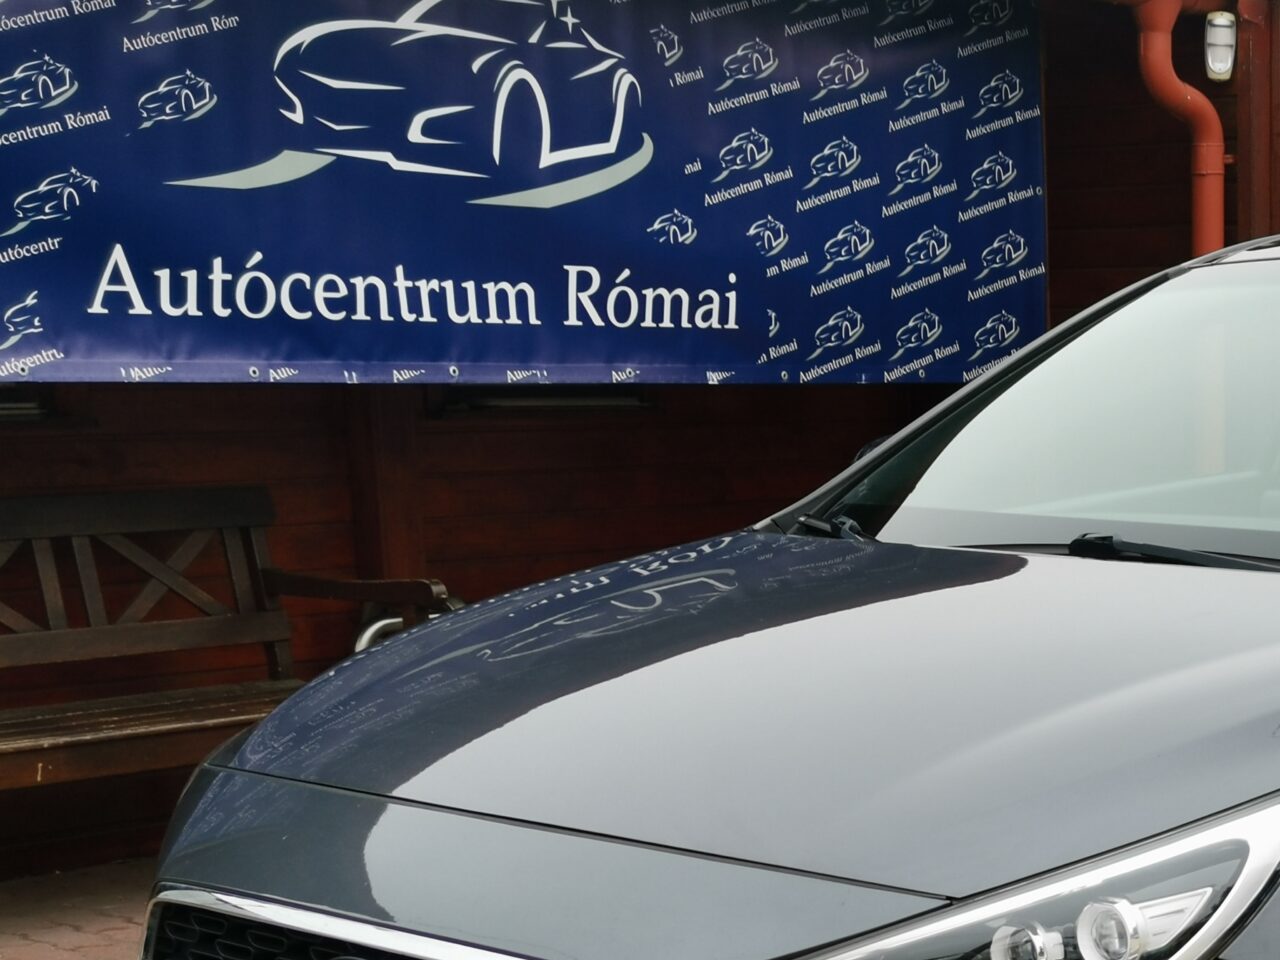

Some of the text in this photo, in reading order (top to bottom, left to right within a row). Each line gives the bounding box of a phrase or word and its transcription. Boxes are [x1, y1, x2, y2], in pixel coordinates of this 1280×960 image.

[71, 0, 116, 15] Római
[690, 1, 749, 24] Autócentrum
[784, 4, 869, 37] Autócentrum Római
[122, 20, 208, 52] Autócentrum
[873, 16, 954, 49] Autócentrum Római
[957, 28, 1029, 59] Autócentrum Római
[675, 66, 704, 86] Római
[707, 77, 801, 115] Autócentrum Római
[802, 87, 887, 124] Autócentrum Római
[888, 96, 965, 133] Autócentrum Római
[65, 105, 111, 130] Római
[965, 106, 1041, 141] Autócentrum Római
[704, 166, 793, 207] Autócentrum Római
[796, 173, 880, 213] Autócentrum Római
[881, 179, 958, 218] Autócentrum Római
[958, 185, 1034, 223] Autócentrum Római
[780, 251, 809, 272] Római
[810, 256, 891, 297] Autócentrum Római
[890, 259, 967, 300] Autócentrum Római
[87, 243, 739, 329] Autócentrum Római
[967, 262, 1045, 302] Autócentrum Római
[769, 338, 798, 360] Római
[800, 340, 881, 384] Autócentrum Római
[883, 341, 960, 383] Autócentrum Római
